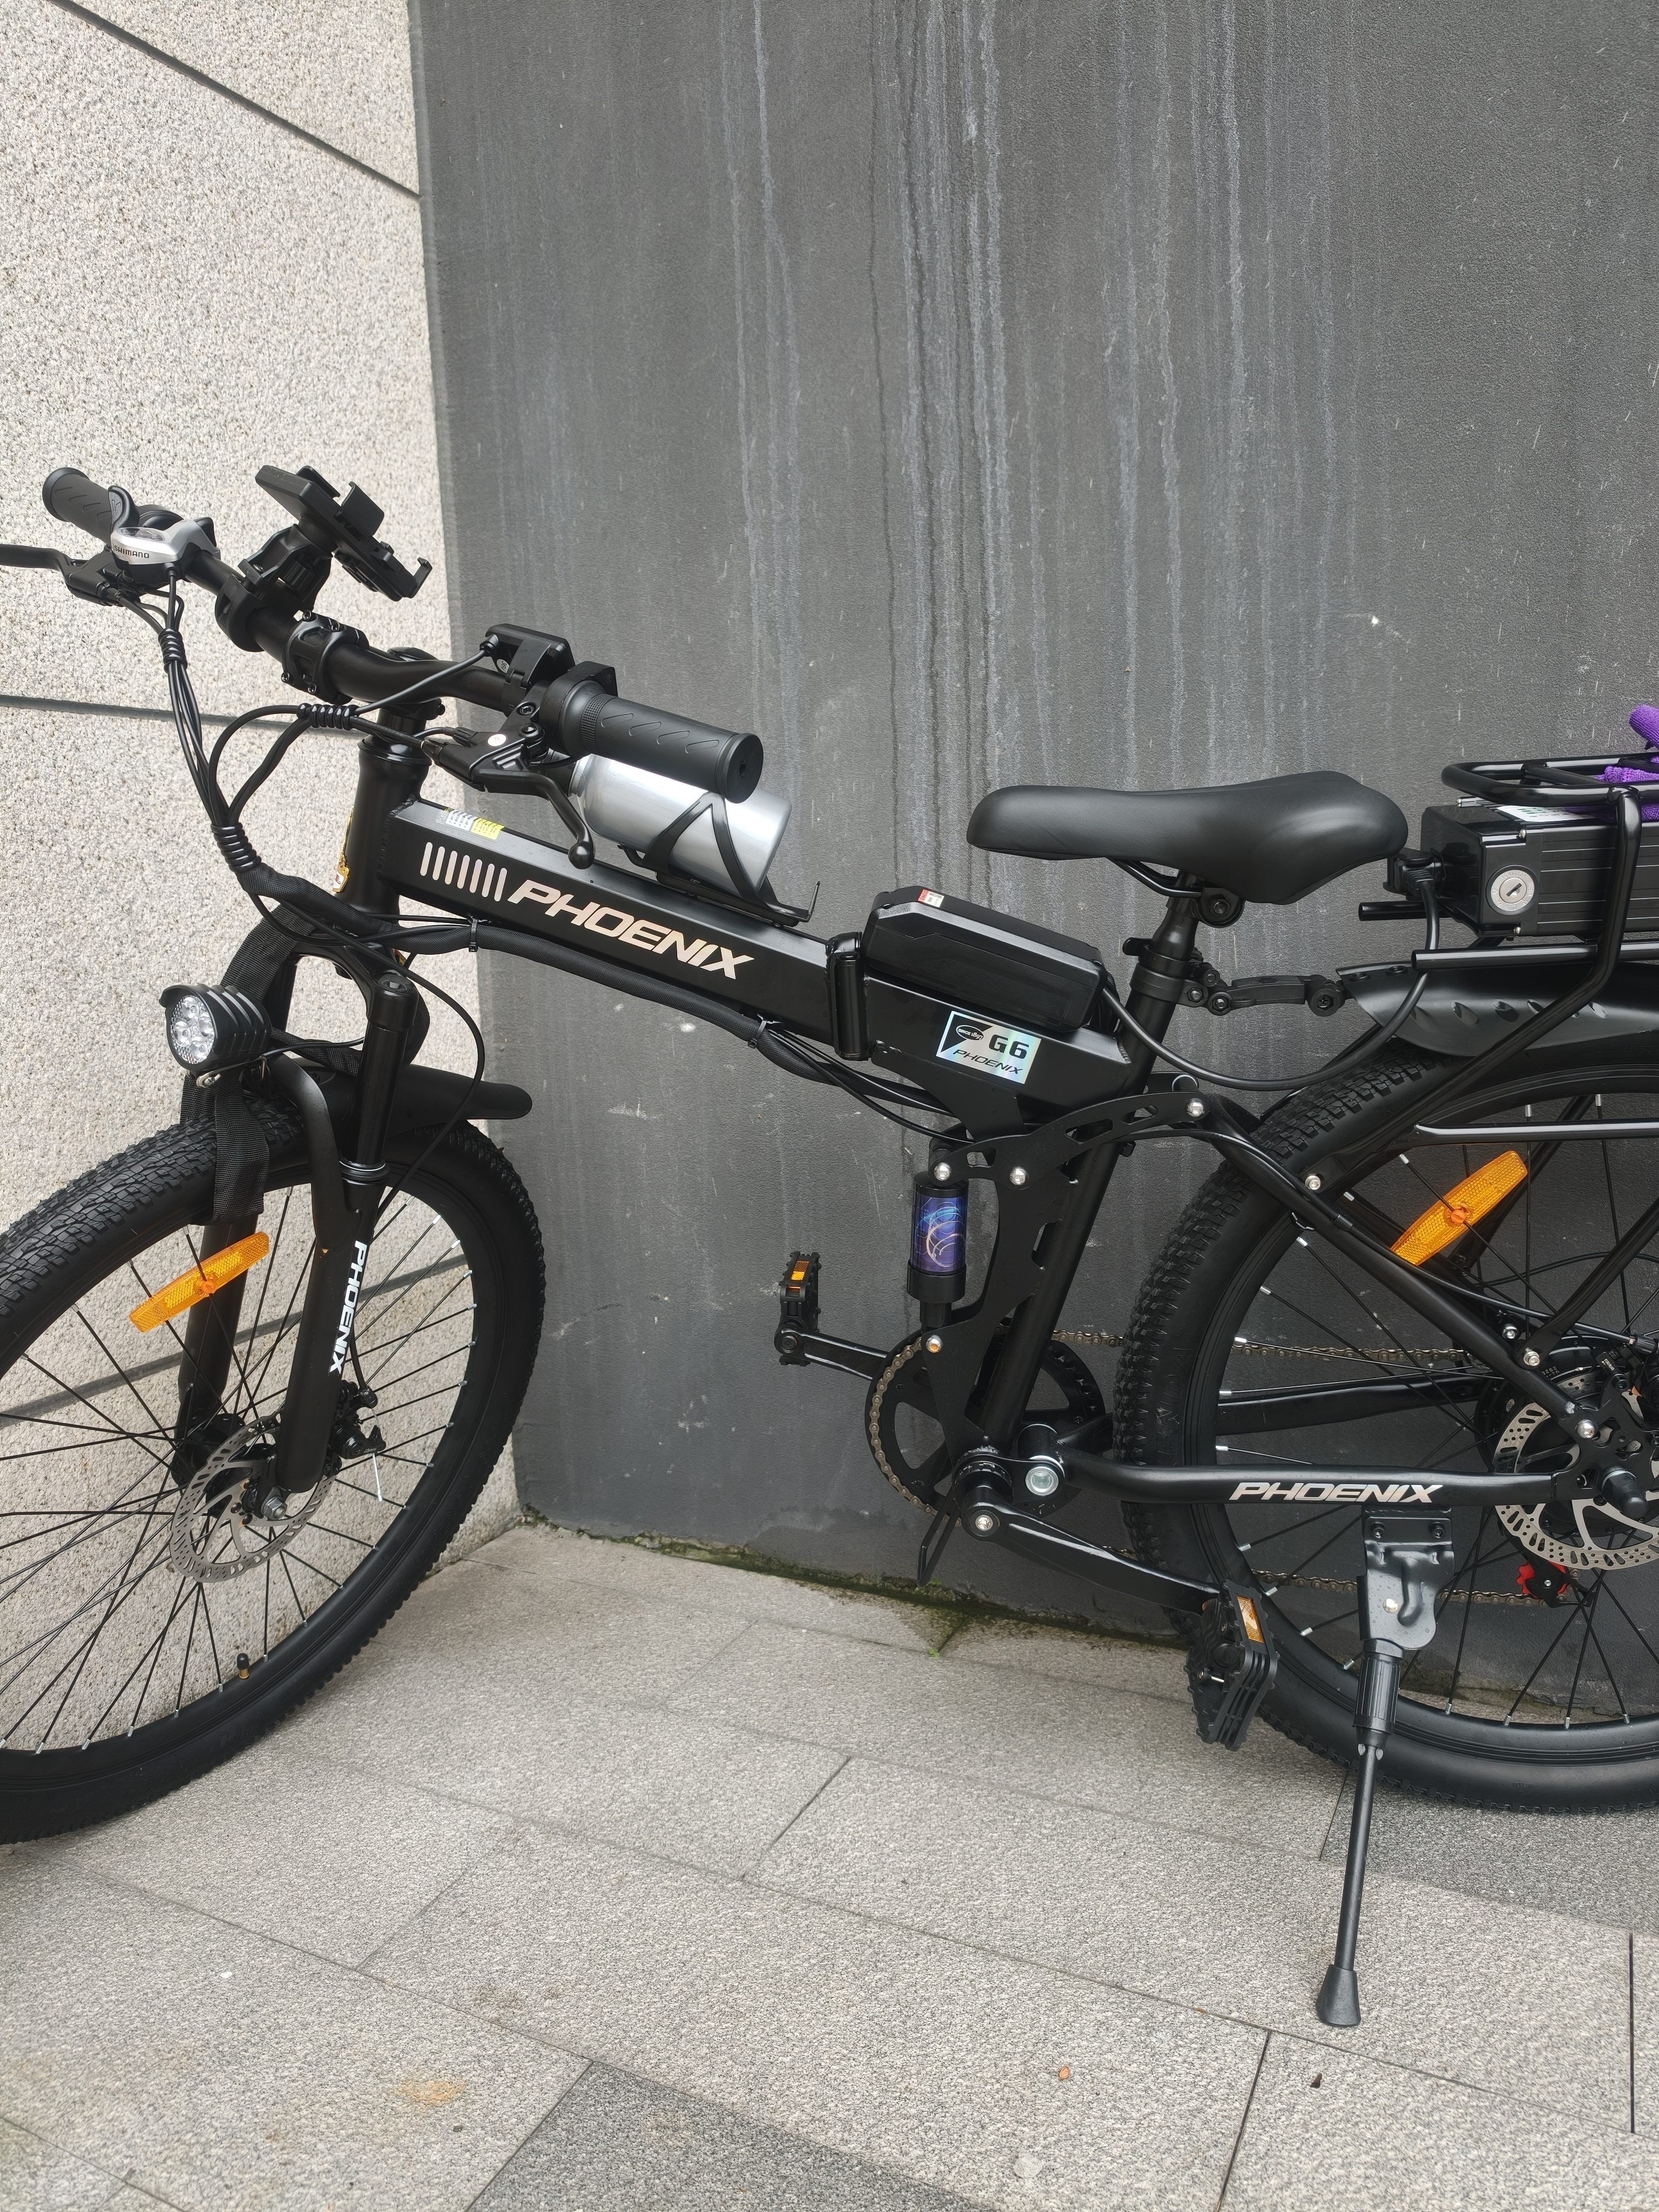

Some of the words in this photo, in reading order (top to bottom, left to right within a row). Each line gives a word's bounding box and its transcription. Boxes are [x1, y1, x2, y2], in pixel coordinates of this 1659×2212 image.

[114, 545, 150, 558] SHIMANO
[507, 879, 755, 980] PHOENIX
[971, 1032, 983, 1040] 1897
[988, 1034, 1029, 1059] G6
[953, 1049, 1023, 1074] PHOENIX
[329, 1240, 368, 1375] PHOENIX
[1229, 1482, 1443, 1503] PHOENIX
